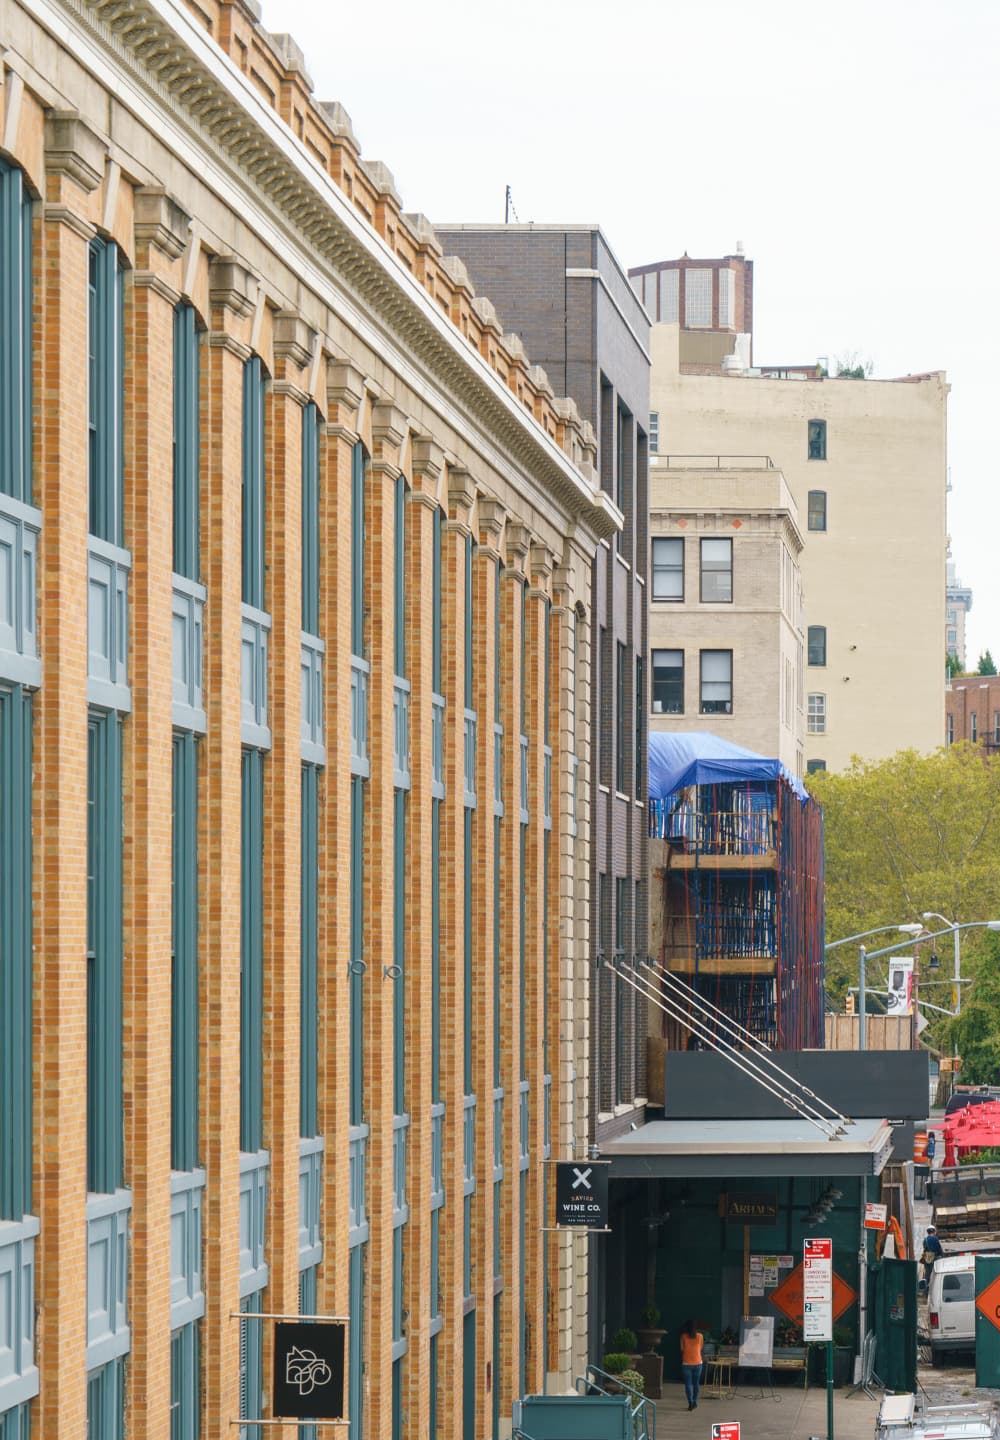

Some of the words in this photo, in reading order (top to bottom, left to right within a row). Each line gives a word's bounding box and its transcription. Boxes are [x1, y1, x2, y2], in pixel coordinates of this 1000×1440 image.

[587, 1204, 601, 1212] CO.
[806, 1260, 810, 1268] 3
[806, 1304, 810, 1312] 2
